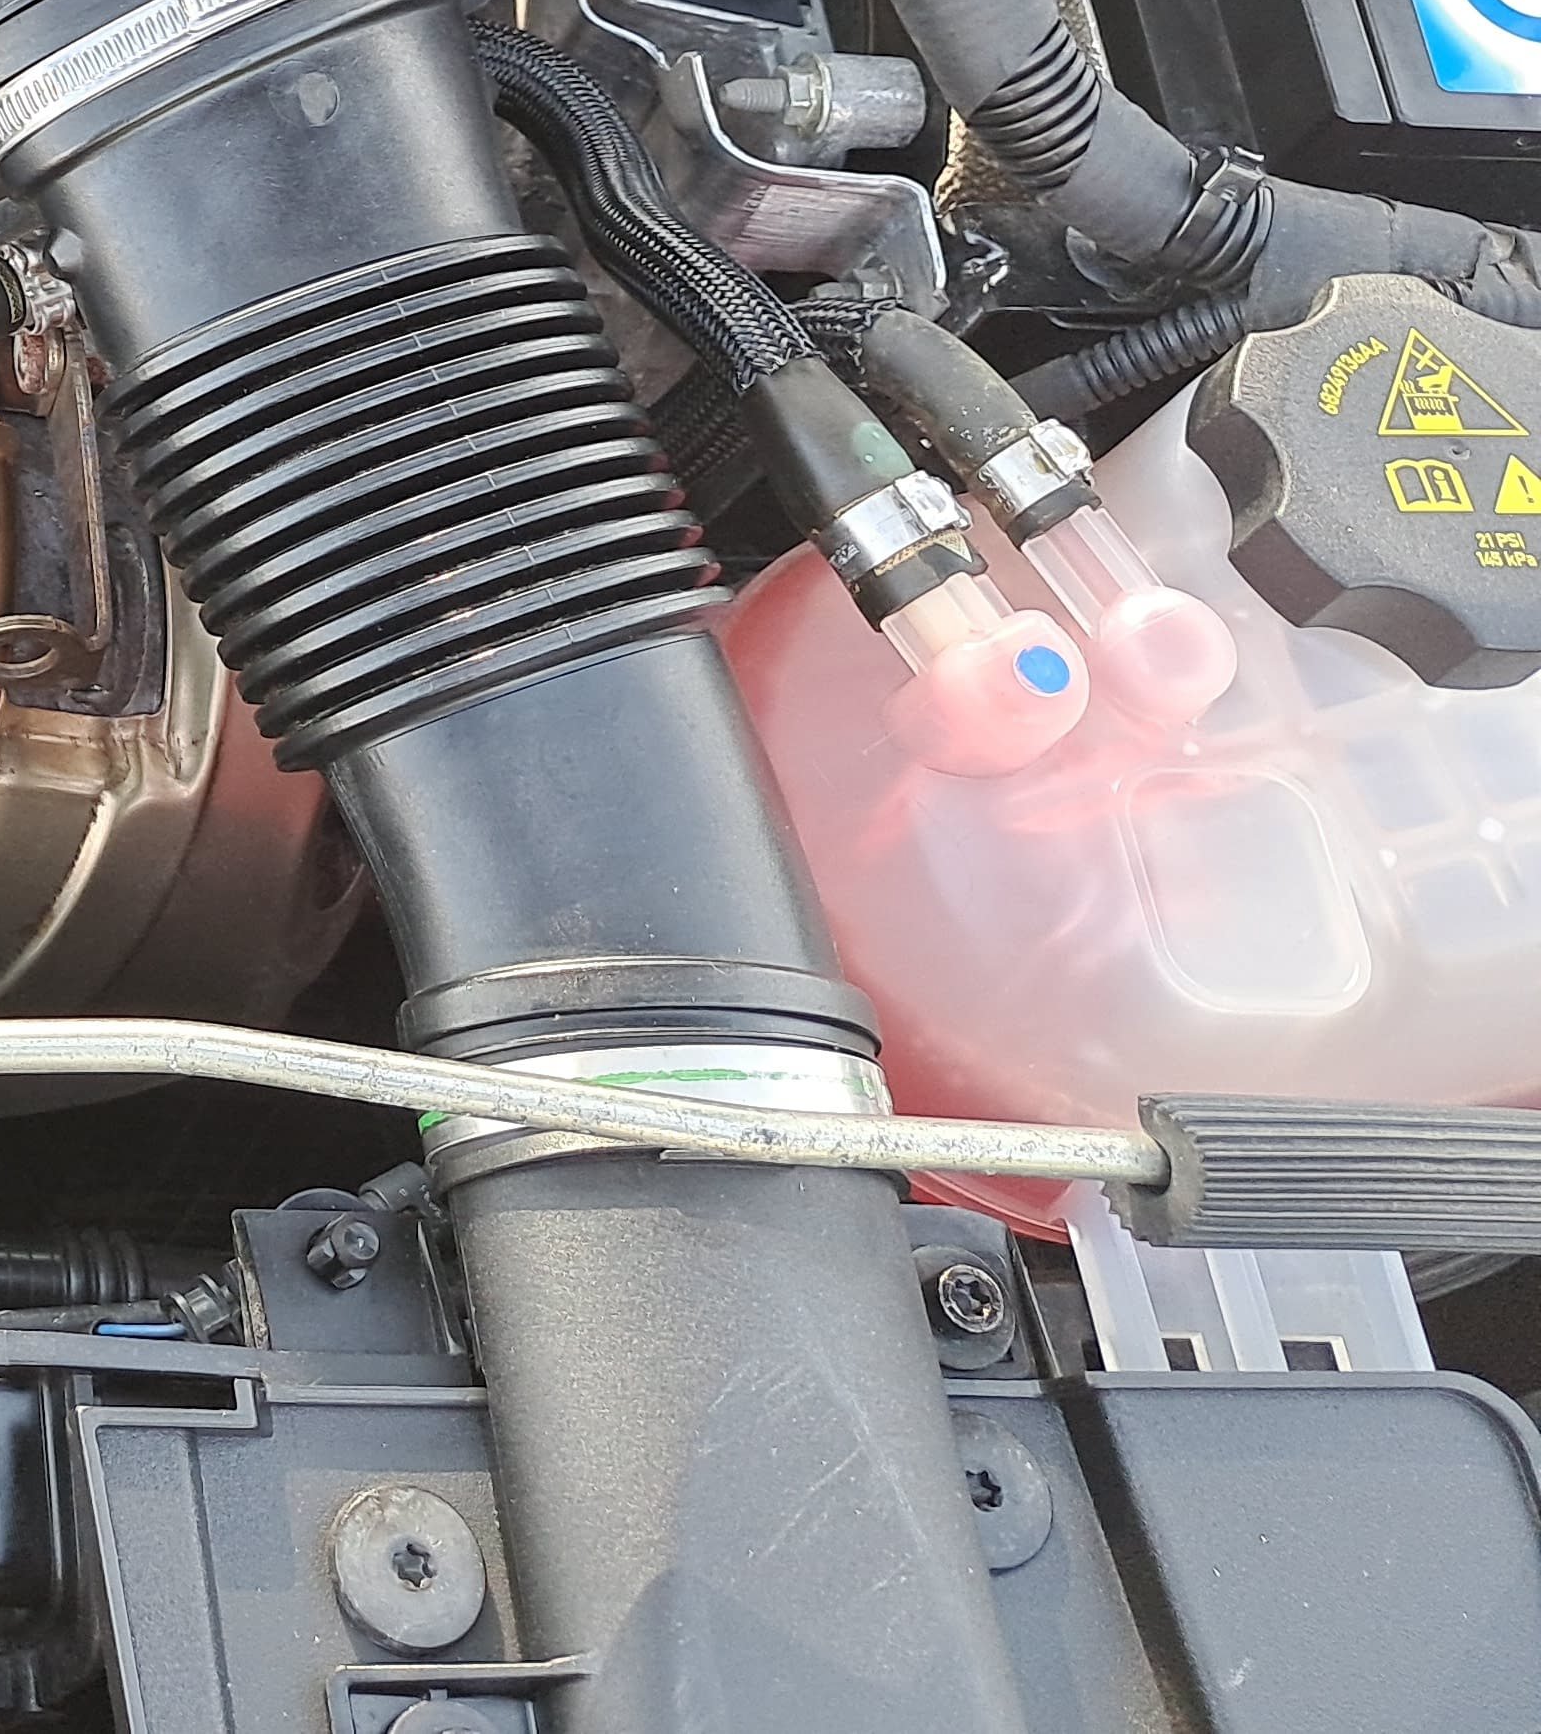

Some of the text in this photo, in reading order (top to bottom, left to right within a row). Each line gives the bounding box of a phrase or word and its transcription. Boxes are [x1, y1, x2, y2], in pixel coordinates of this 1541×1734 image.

[1317, 336, 1390, 415] 68249136AA
[1475, 531, 1526, 550] 21 PSI
[1504, 550, 1538, 567] kPa
